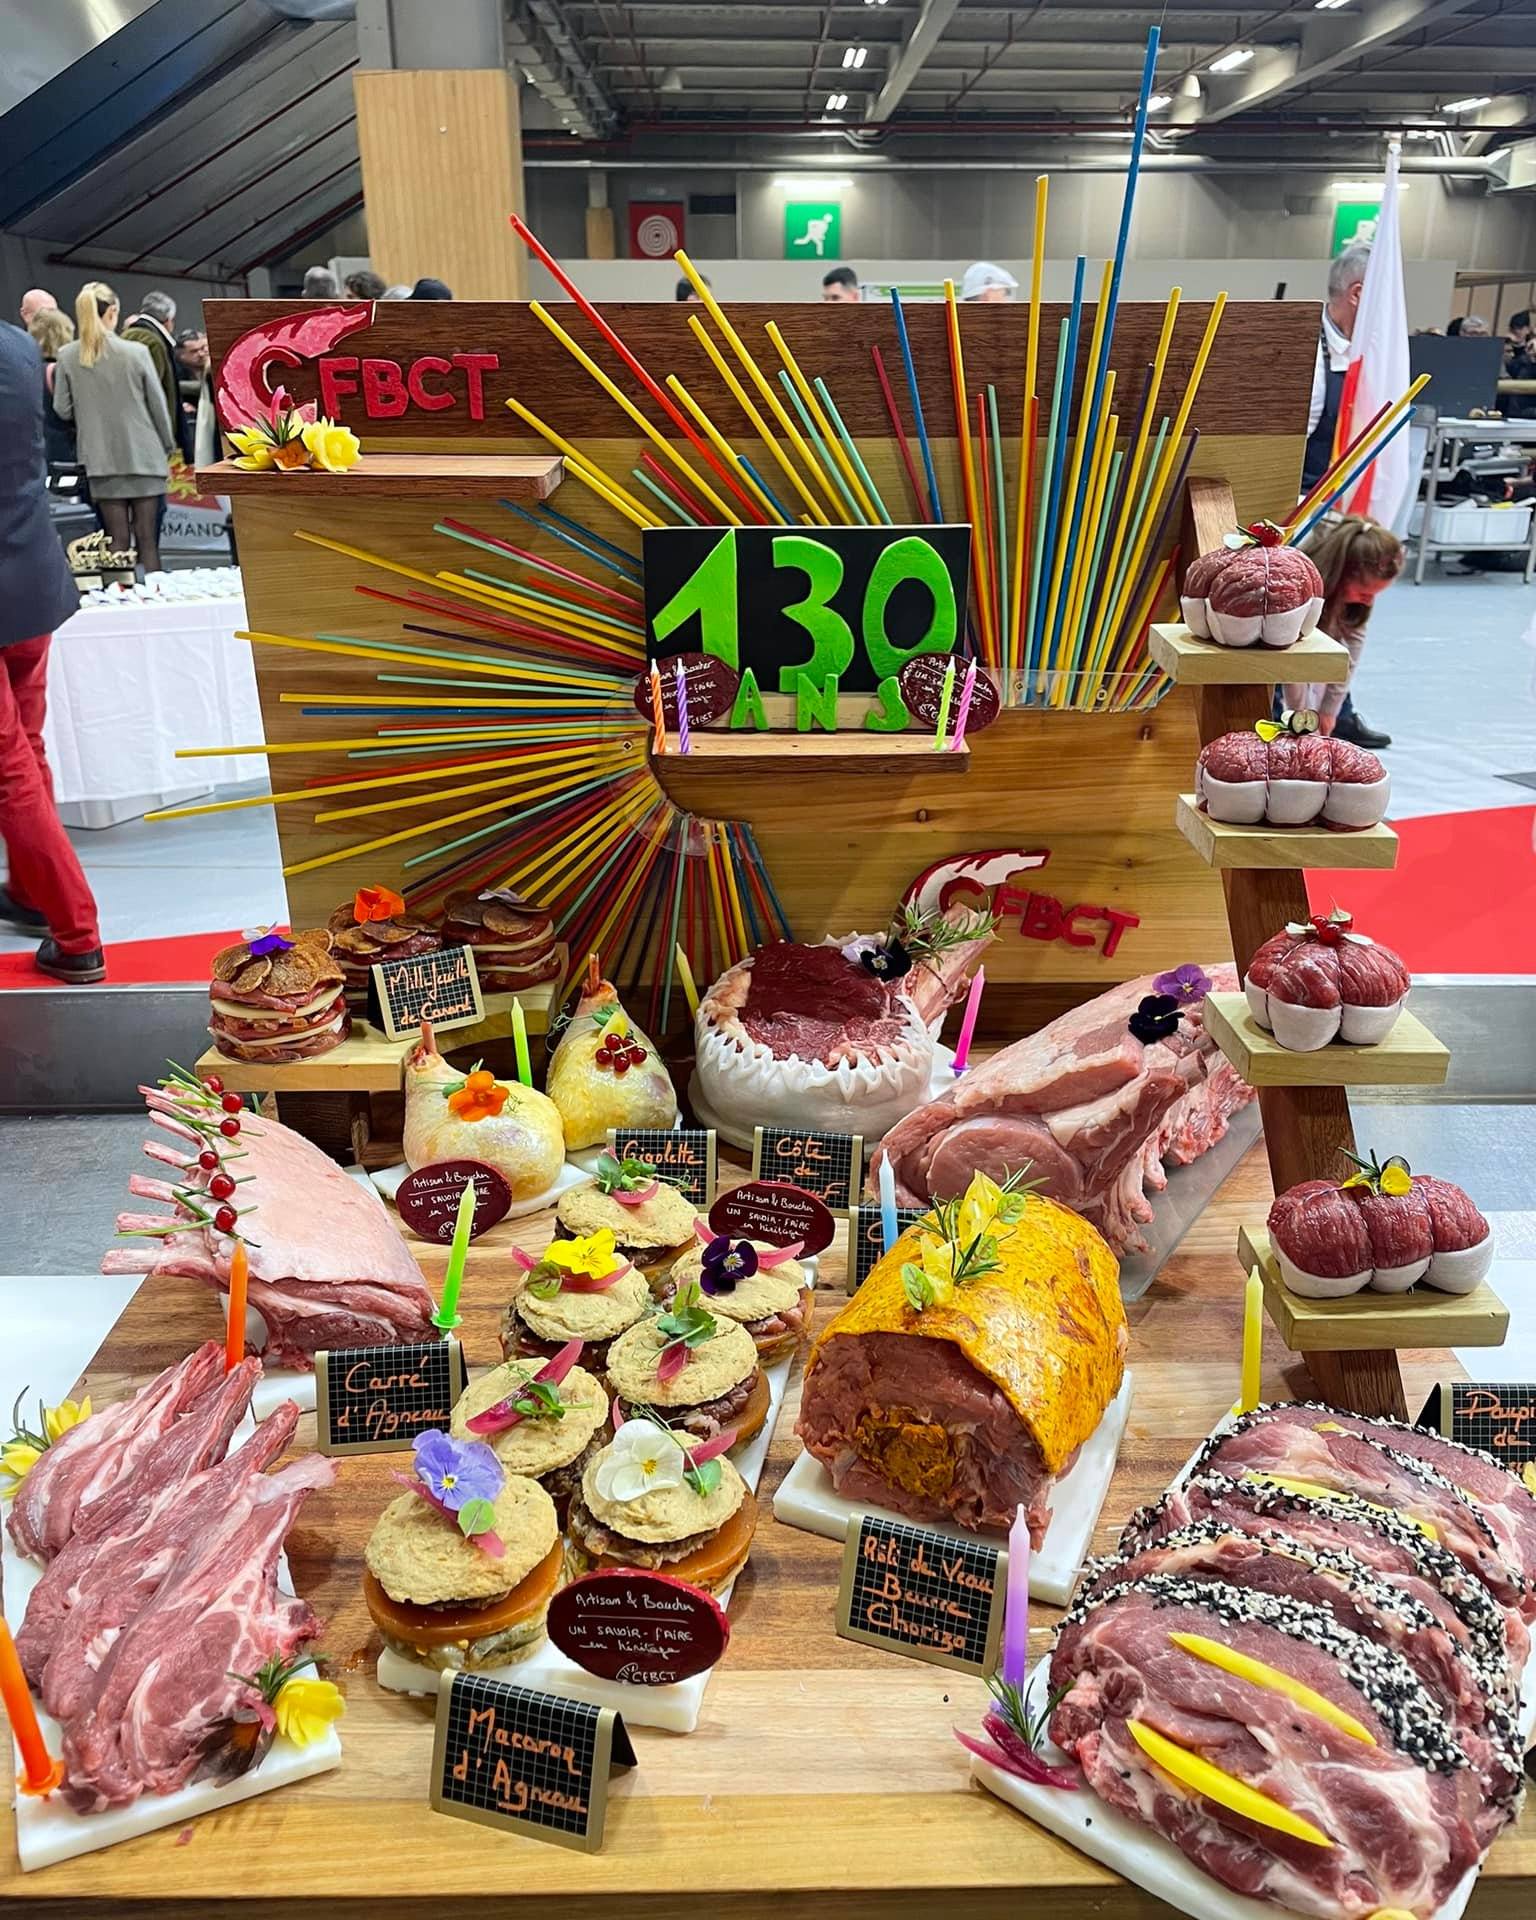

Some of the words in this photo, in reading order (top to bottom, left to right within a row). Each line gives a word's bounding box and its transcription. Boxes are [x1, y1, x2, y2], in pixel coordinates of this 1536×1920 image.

[652, 528, 957, 693] 130
[730, 667, 911, 732] ANS
[401, 1005, 420, 1024] de
[776, 1135, 832, 1160] Côte
[794, 1161, 820, 1176] de
[410, 1197, 423, 1207] UN
[737, 1189, 769, 1204] Artisan
[726, 1207, 741, 1216] UN
[345, 1355, 430, 1393] Carré
[1493, 1425, 1531, 1446] de
[863, 1535, 899, 1567] Rôti
[910, 1543, 937, 1577] de
[942, 1556, 994, 1595] Veau
[575, 1592, 621, 1607] Artisan
[863, 1572, 972, 1620] Beurre
[568, 1625, 588, 1635] UN
[866, 1602, 966, 1653] Chorizo
[632, 1670, 677, 1683] CFBCT
[468, 1706, 582, 1776] Macaron
